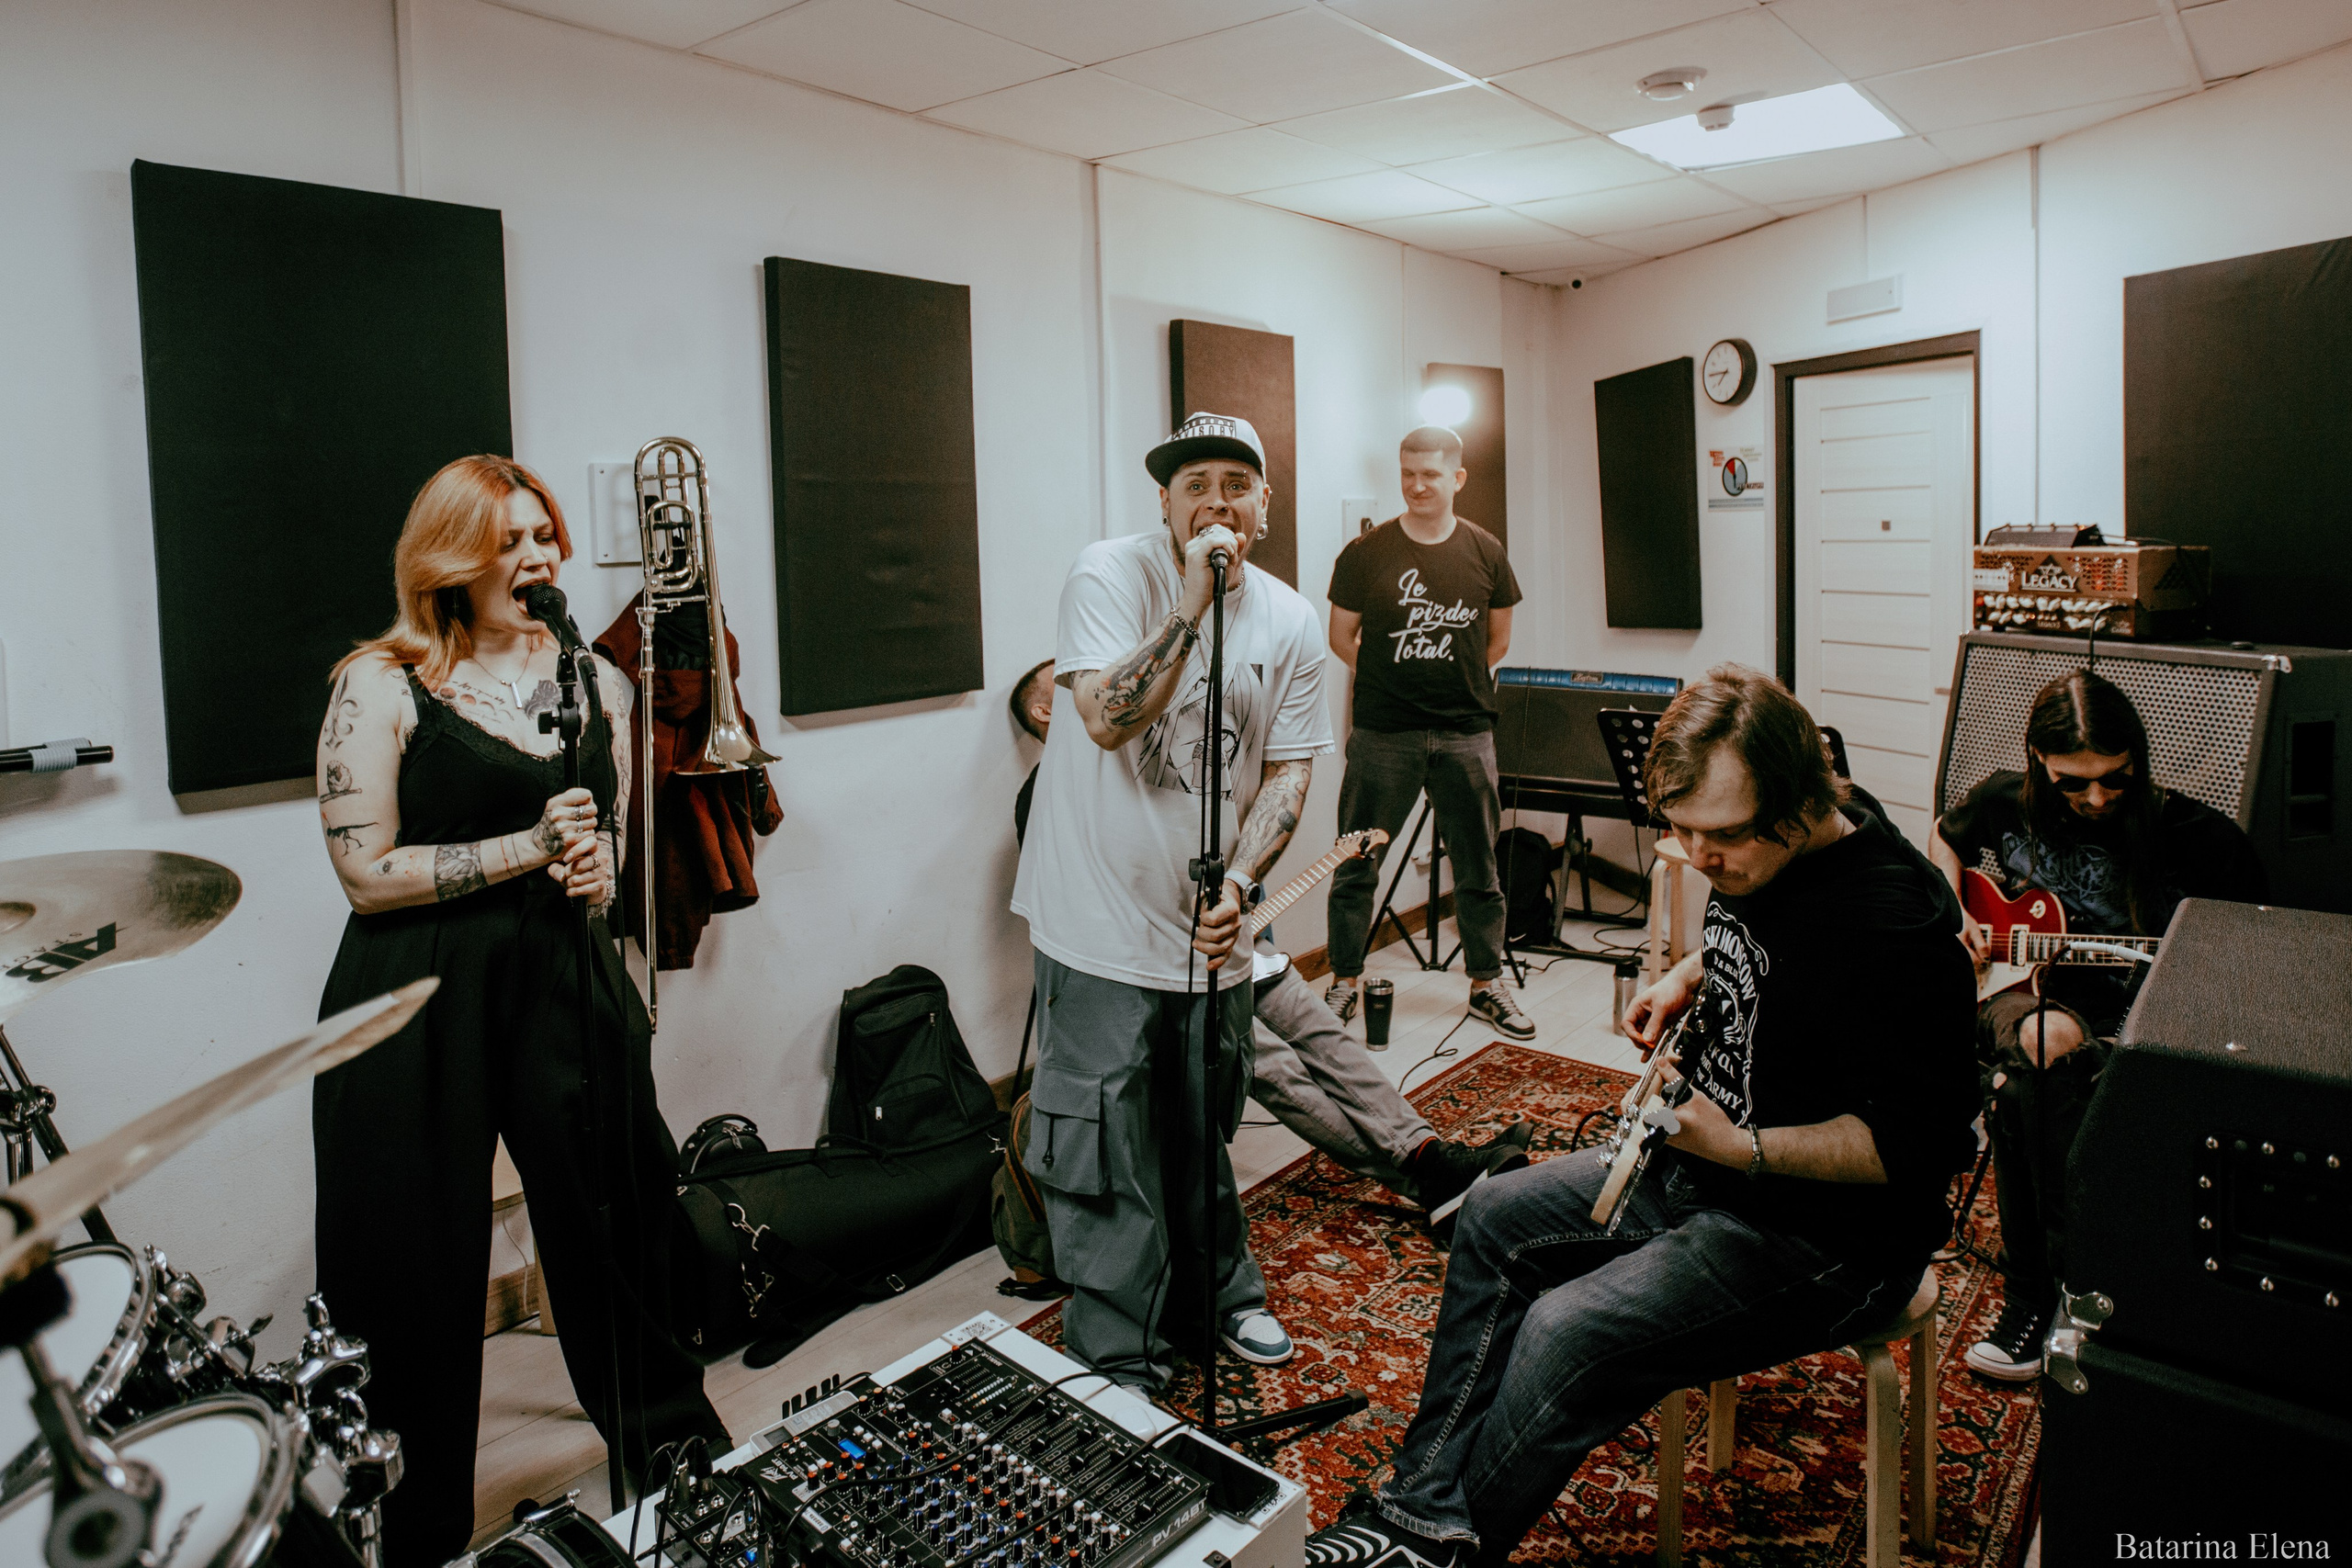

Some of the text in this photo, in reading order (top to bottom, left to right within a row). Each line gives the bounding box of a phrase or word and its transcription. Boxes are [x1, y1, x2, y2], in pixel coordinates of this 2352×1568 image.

[1177, 425, 1235, 439] VISORY
[2021, 570, 2077, 589] LEGACY
[1407, 598, 1478, 632] pizdec
[1388, 627, 1453, 663] Total.
[1718, 927, 1757, 1001] MOSCOW
[1724, 963, 1738, 980] BLU
[1704, 1074, 1744, 1110] ARMY
